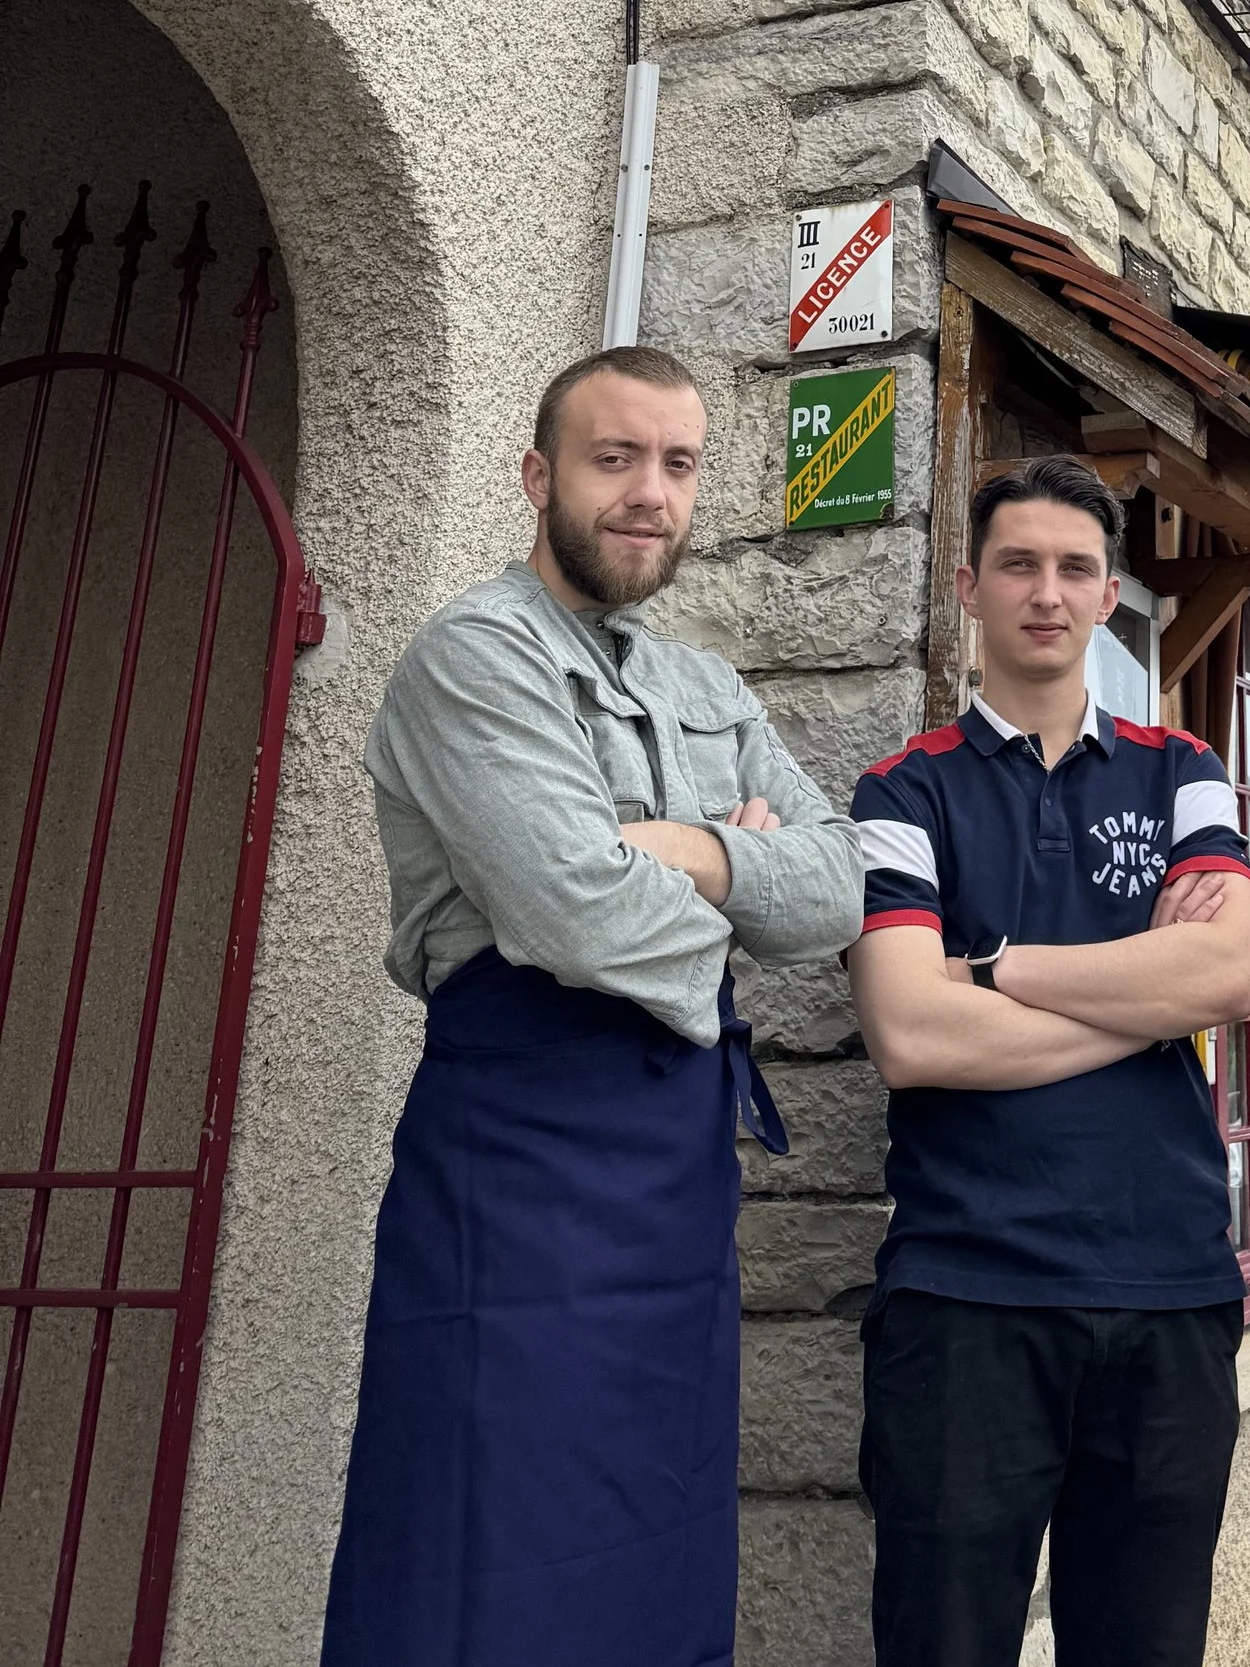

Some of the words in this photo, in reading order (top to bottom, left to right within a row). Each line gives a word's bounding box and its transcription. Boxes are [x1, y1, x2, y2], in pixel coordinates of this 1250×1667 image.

[797, 220, 821, 248] III
[797, 225, 882, 325] LICENCE
[800, 252, 816, 270] 21
[828, 313, 875, 334] 30021
[791, 404, 832, 440] PR
[788, 378, 892, 520] RESTAURANT
[795, 443, 813, 458] 21
[814, 498, 835, 509] Décret
[835, 496, 845, 506] du
[845, 494, 851, 505] 8
[851, 492, 875, 504] Février
[877, 489, 892, 501] 1955
[1088, 811, 1165, 845] TOMMY
[1112, 841, 1151, 866] NYC
[1091, 853, 1167, 898] JEANS
